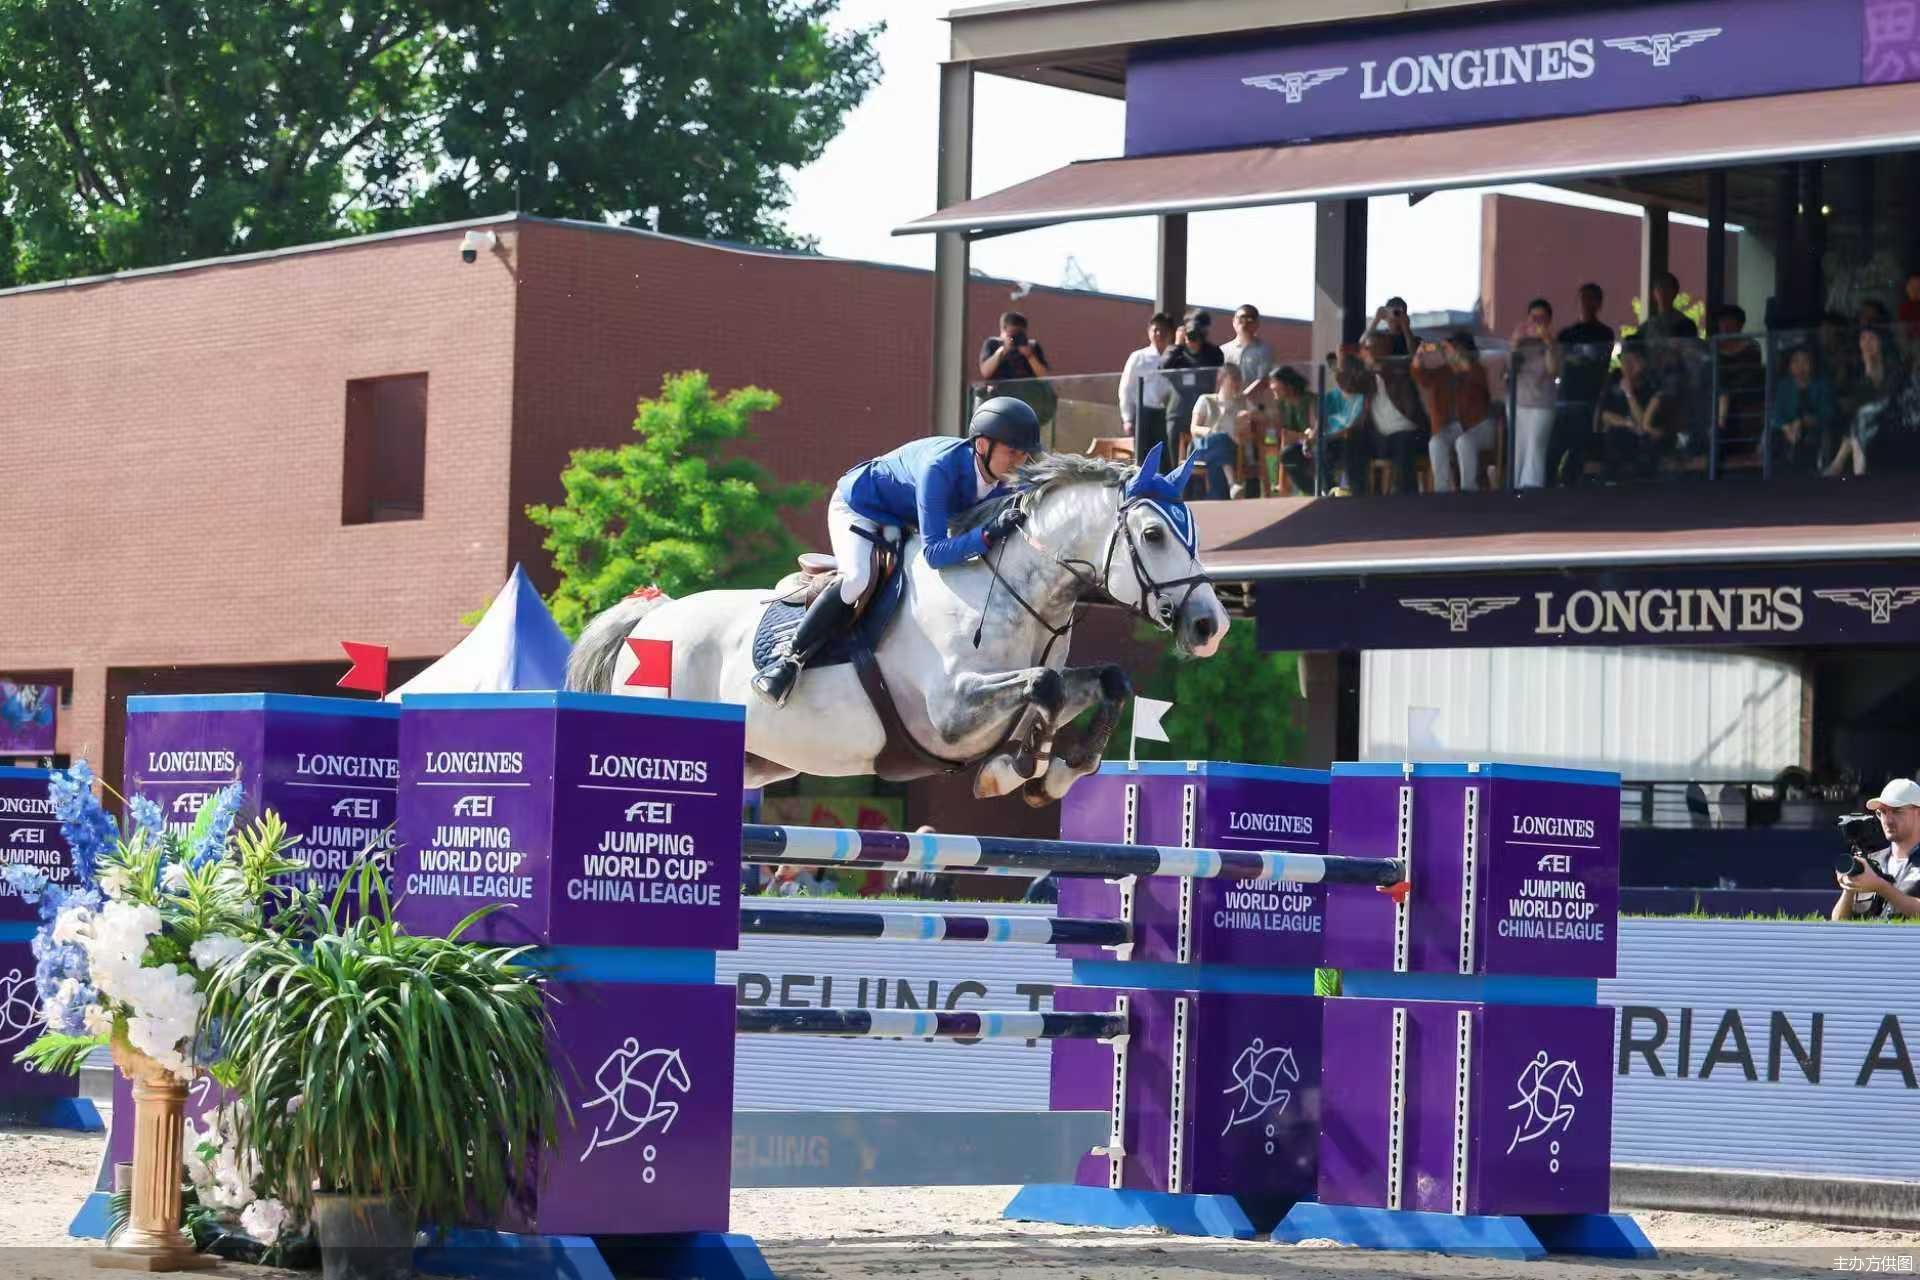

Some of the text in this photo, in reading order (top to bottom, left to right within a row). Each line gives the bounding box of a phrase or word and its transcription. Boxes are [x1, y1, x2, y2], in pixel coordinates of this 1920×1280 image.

[1359, 38, 1595, 100] LONGINES
[1534, 586, 1805, 634] LONGINES
[148, 751, 235, 772] LONGINES
[296, 753, 400, 779] LONGINE
[425, 752, 523, 773] LONGINES
[589, 754, 708, 783] LONGINES
[1229, 812, 1313, 834] LONGINES
[1513, 815, 1594, 839] LONGINES
[306, 825, 397, 849] JUMPING
[431, 826, 511, 848] JUMPING
[598, 831, 694, 856] JUMPING
[0, 848, 61, 865] UMPING
[420, 850, 482, 872] WORLD
[583, 854, 661, 879] WORLD
[406, 873, 533, 899] CHINA LEAGUE
[567, 878, 721, 906] CHINA LEAGUE
[1519, 879, 1585, 900] JUMPING
[1225, 892, 1313, 913] WORLD CUP
[1509, 898, 1595, 920] WORLD CUP
[1214, 911, 1322, 933] CHINA LEAGUE
[1498, 919, 1605, 941] CHINA LEAGUE
[1618, 1005, 1824, 1085] RIAN
[731, 1135, 830, 1168] EIJING
